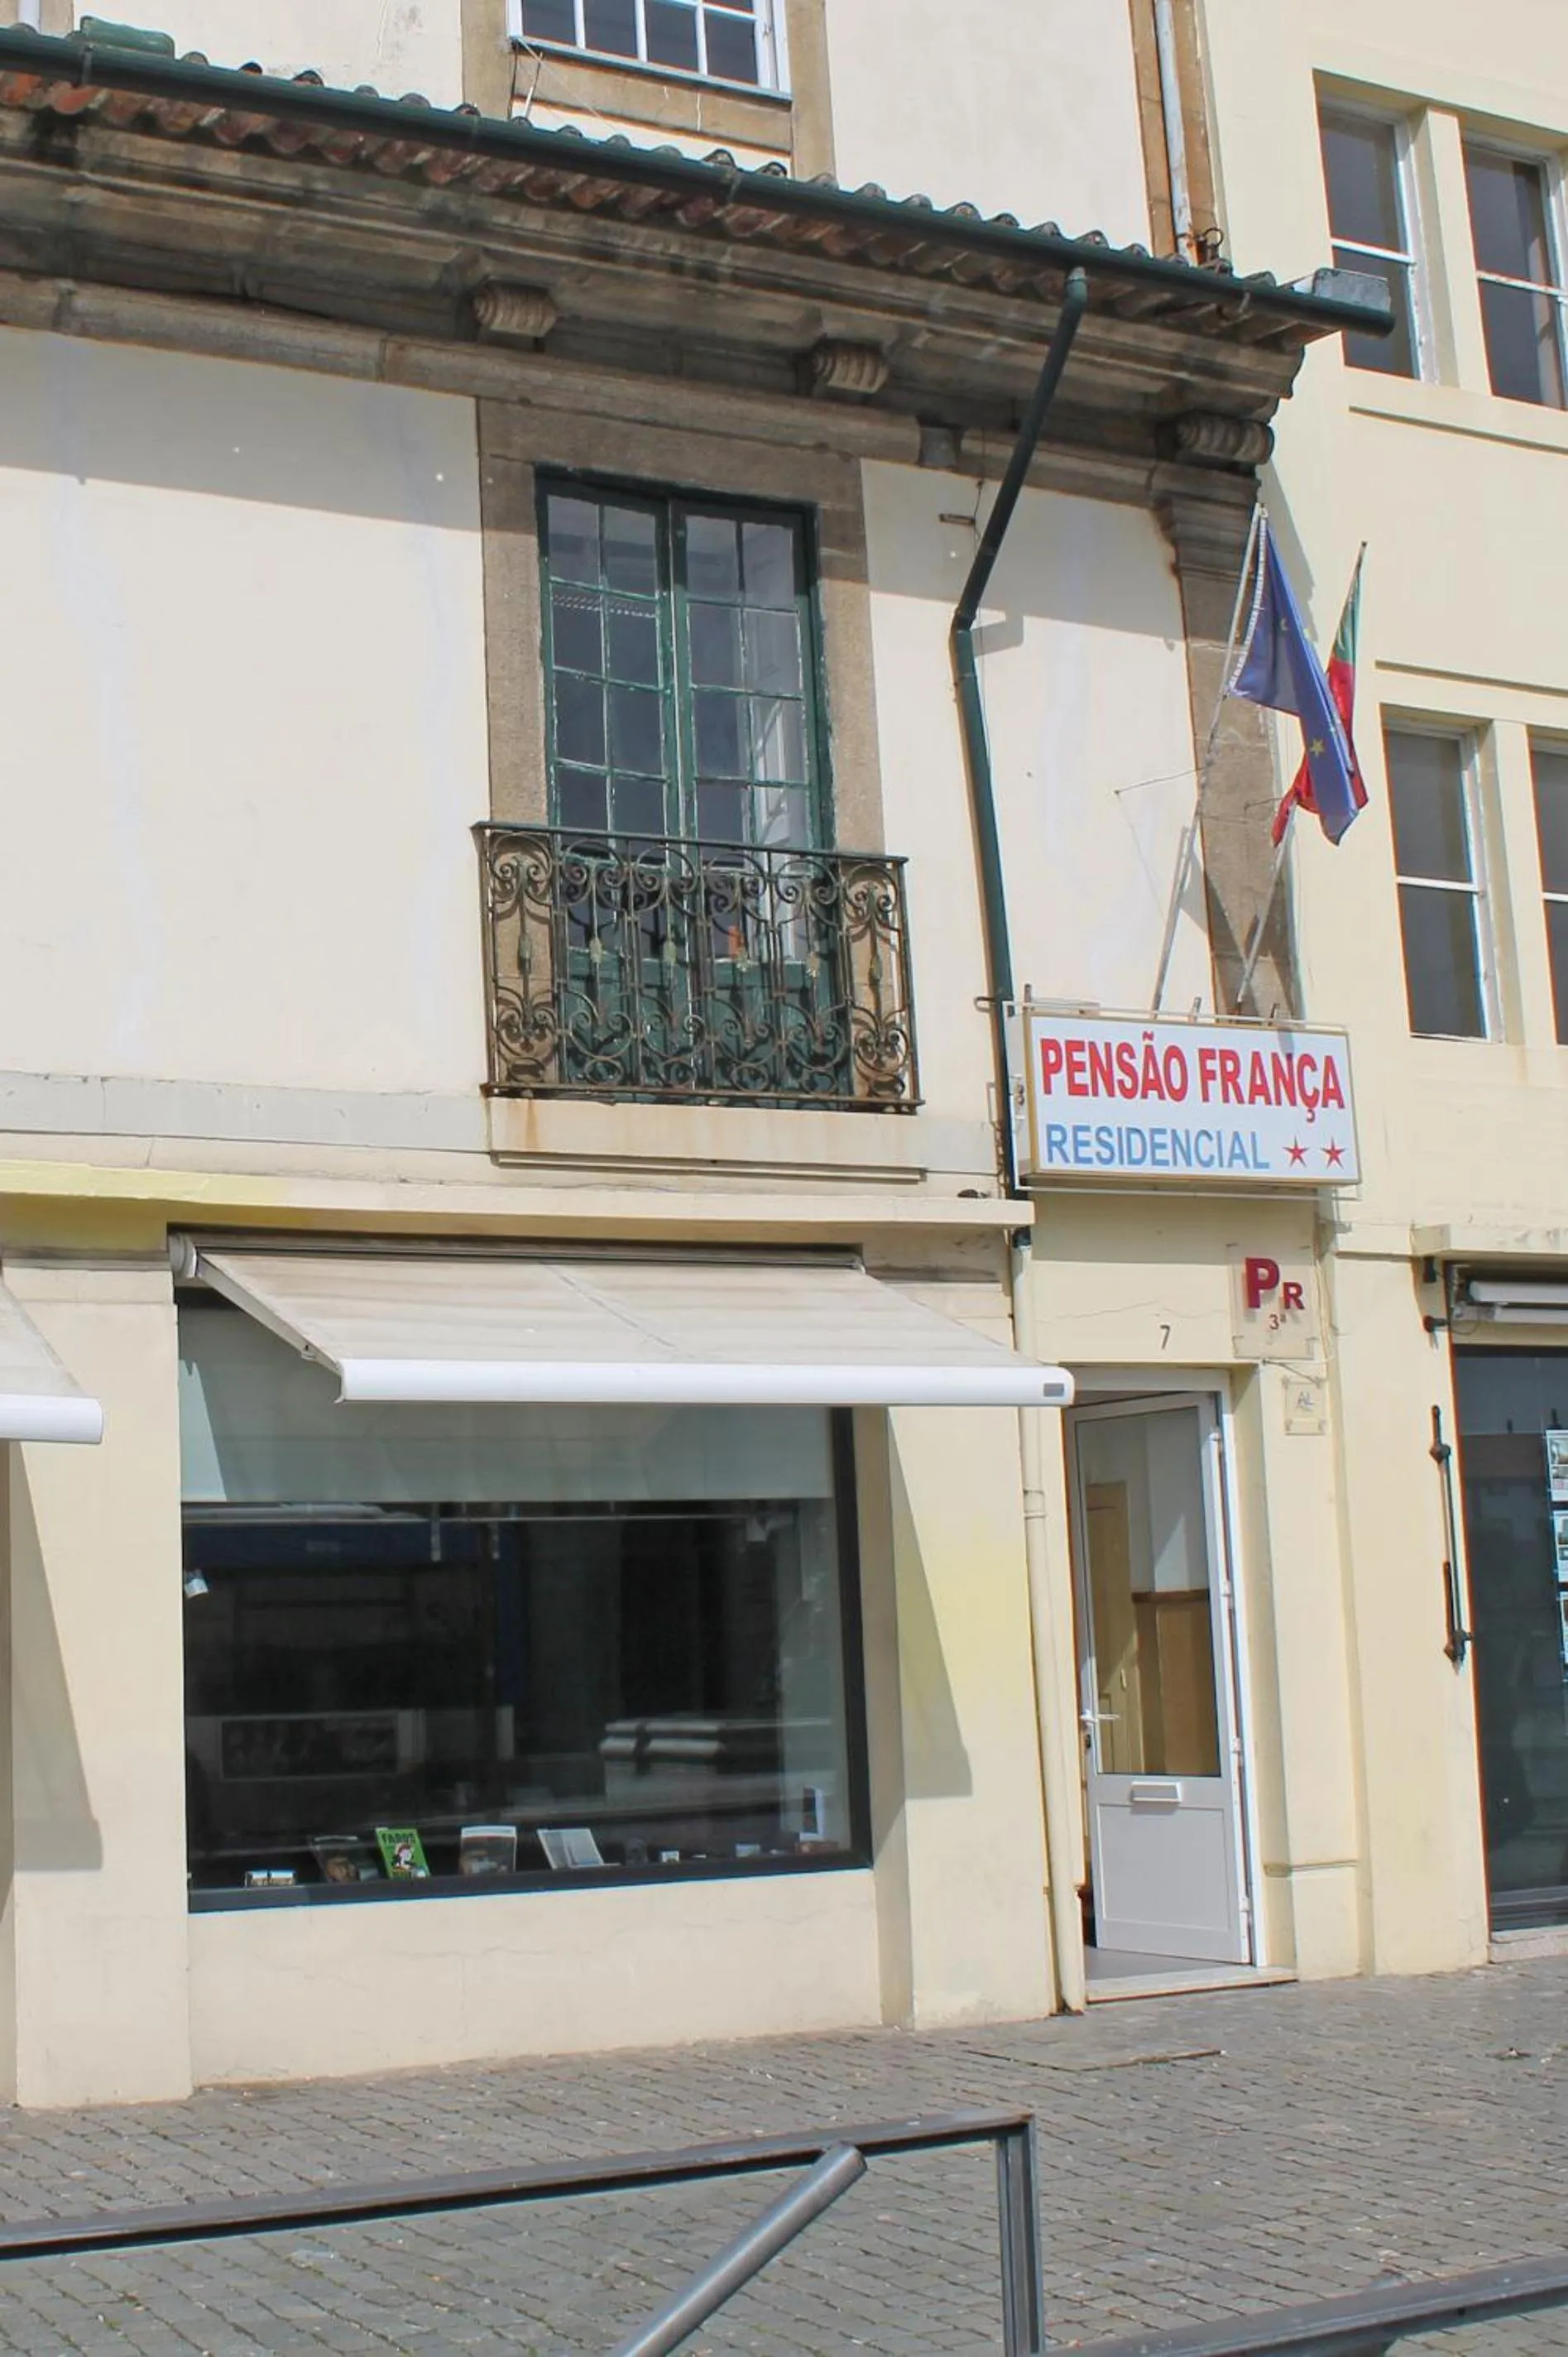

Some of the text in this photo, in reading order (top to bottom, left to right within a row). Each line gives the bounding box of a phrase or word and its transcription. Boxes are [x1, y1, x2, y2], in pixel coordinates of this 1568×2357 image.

[1040, 1030, 1345, 1122] PENSÃO FRANÇA
[1046, 1123, 1270, 1169] RESIDENCIAL
[1159, 1324, 1171, 1349] 7
[1297, 1390, 1316, 1406] AL
